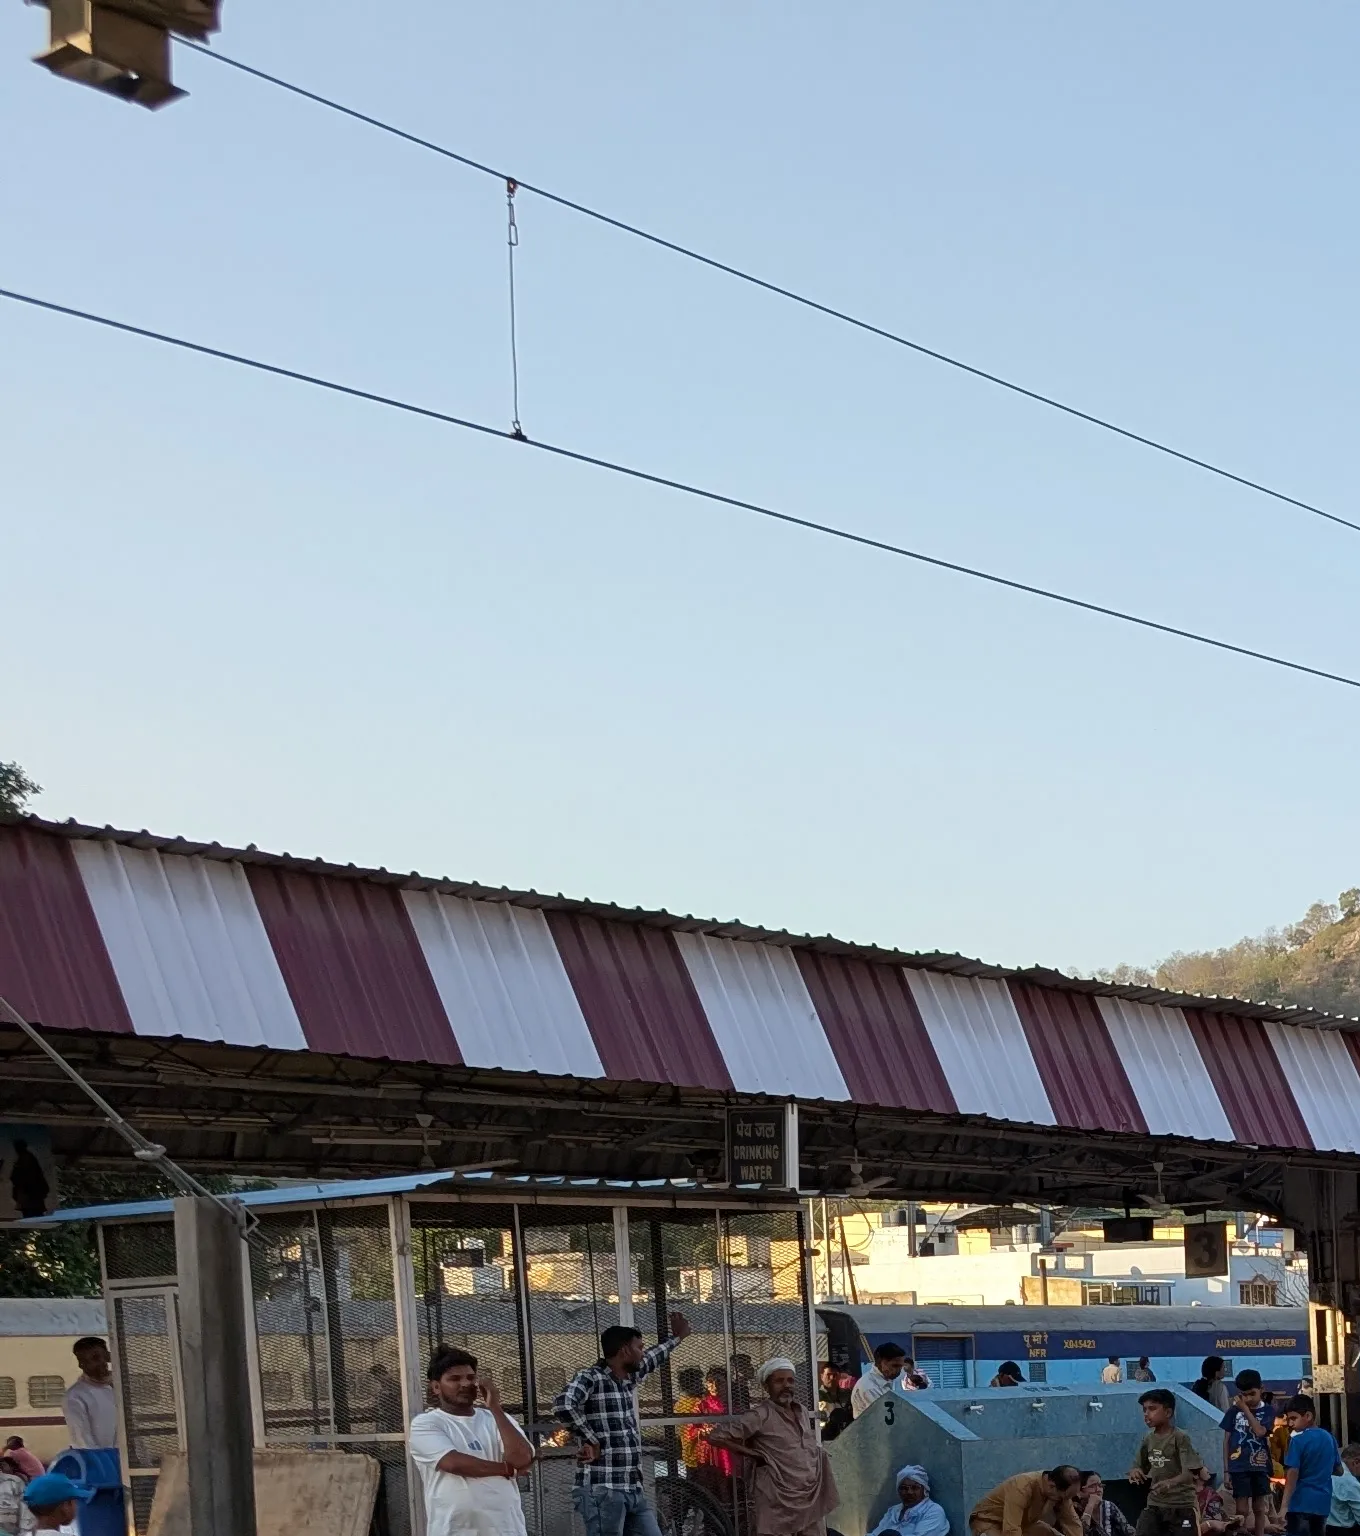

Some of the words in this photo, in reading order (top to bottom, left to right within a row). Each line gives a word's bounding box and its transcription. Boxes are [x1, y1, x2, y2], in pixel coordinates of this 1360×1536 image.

[736, 1119, 752, 1138] पेय
[754, 1122, 776, 1138] जल
[733, 1144, 779, 1160] DRINKING
[740, 1165, 773, 1180] WATER
[1194, 1230, 1218, 1268] 3
[1215, 1338, 1264, 1349] AUTOMOBILE
[1264, 1338, 1297, 1348] CARRIER
[1029, 1348, 1047, 1358] NFR
[884, 1401, 895, 1426] 3
